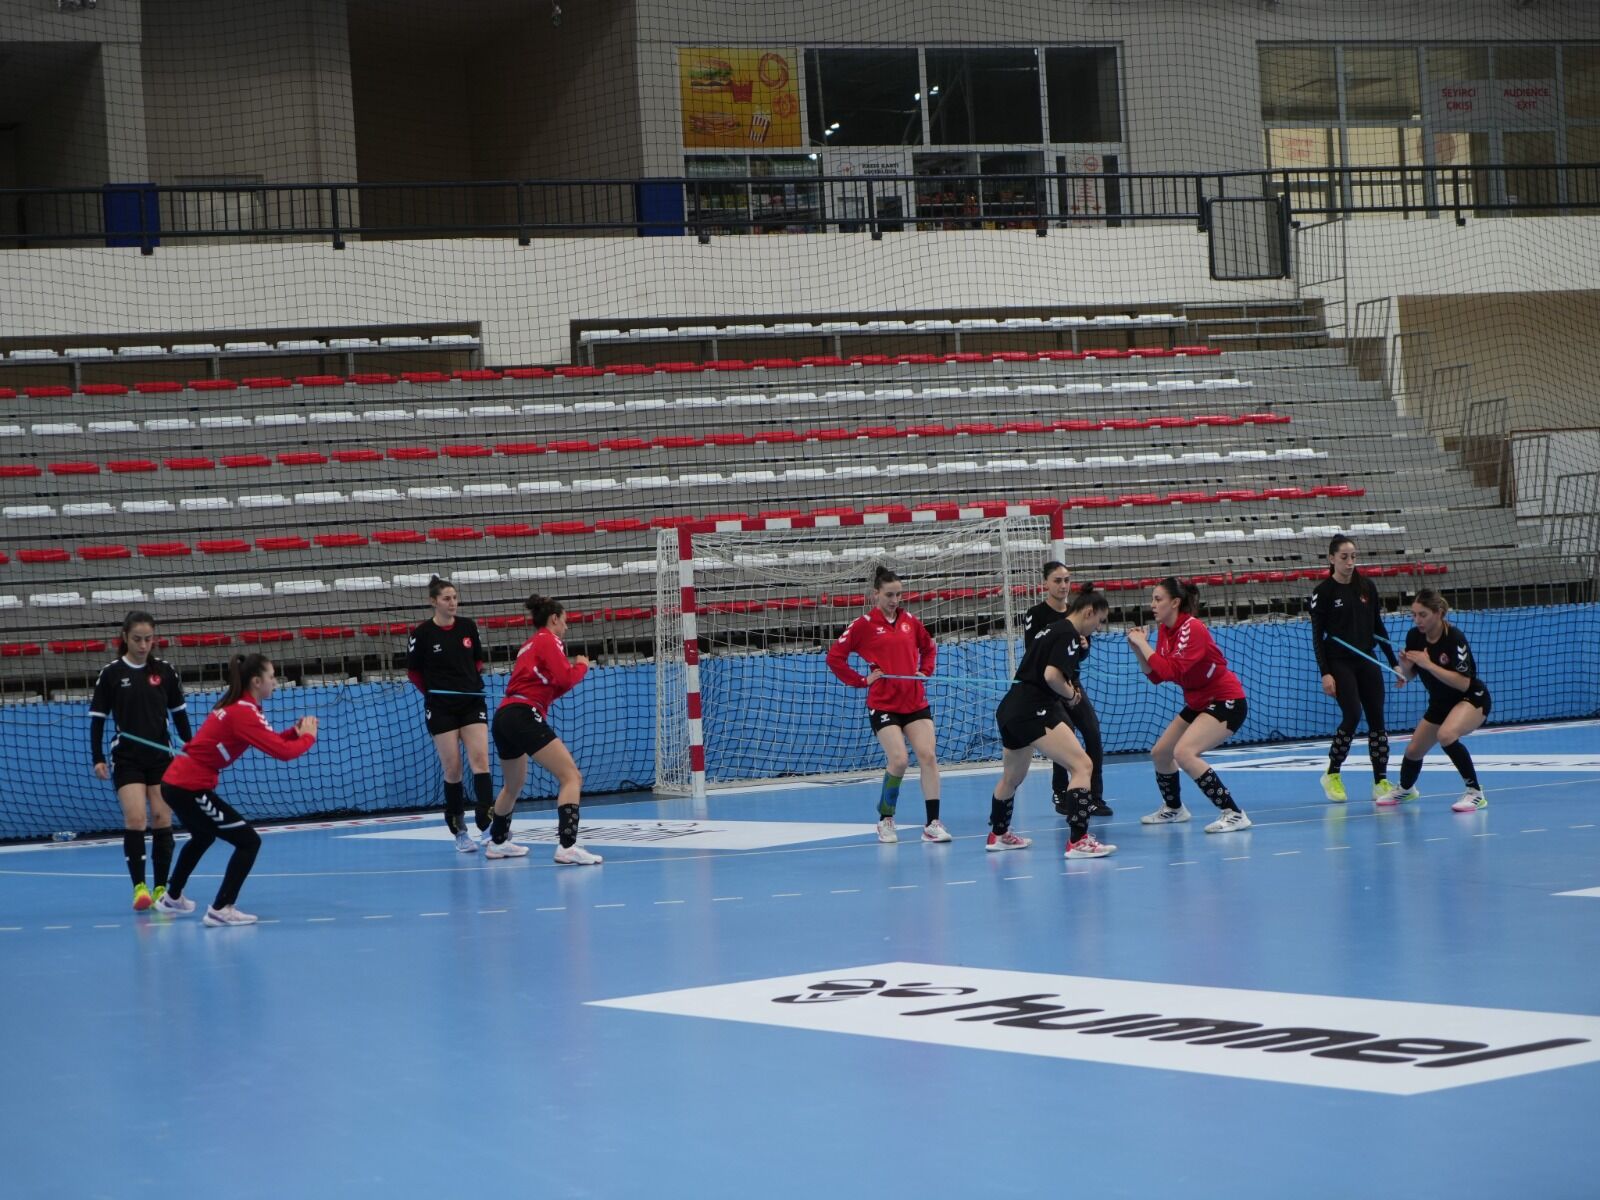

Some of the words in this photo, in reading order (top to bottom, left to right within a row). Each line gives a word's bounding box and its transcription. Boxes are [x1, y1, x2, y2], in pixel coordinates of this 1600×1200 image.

[1503, 88, 1550, 97] AUDIENCE
[1516, 101, 1537, 110] EXIT
[899, 994, 1591, 1067] hummel
